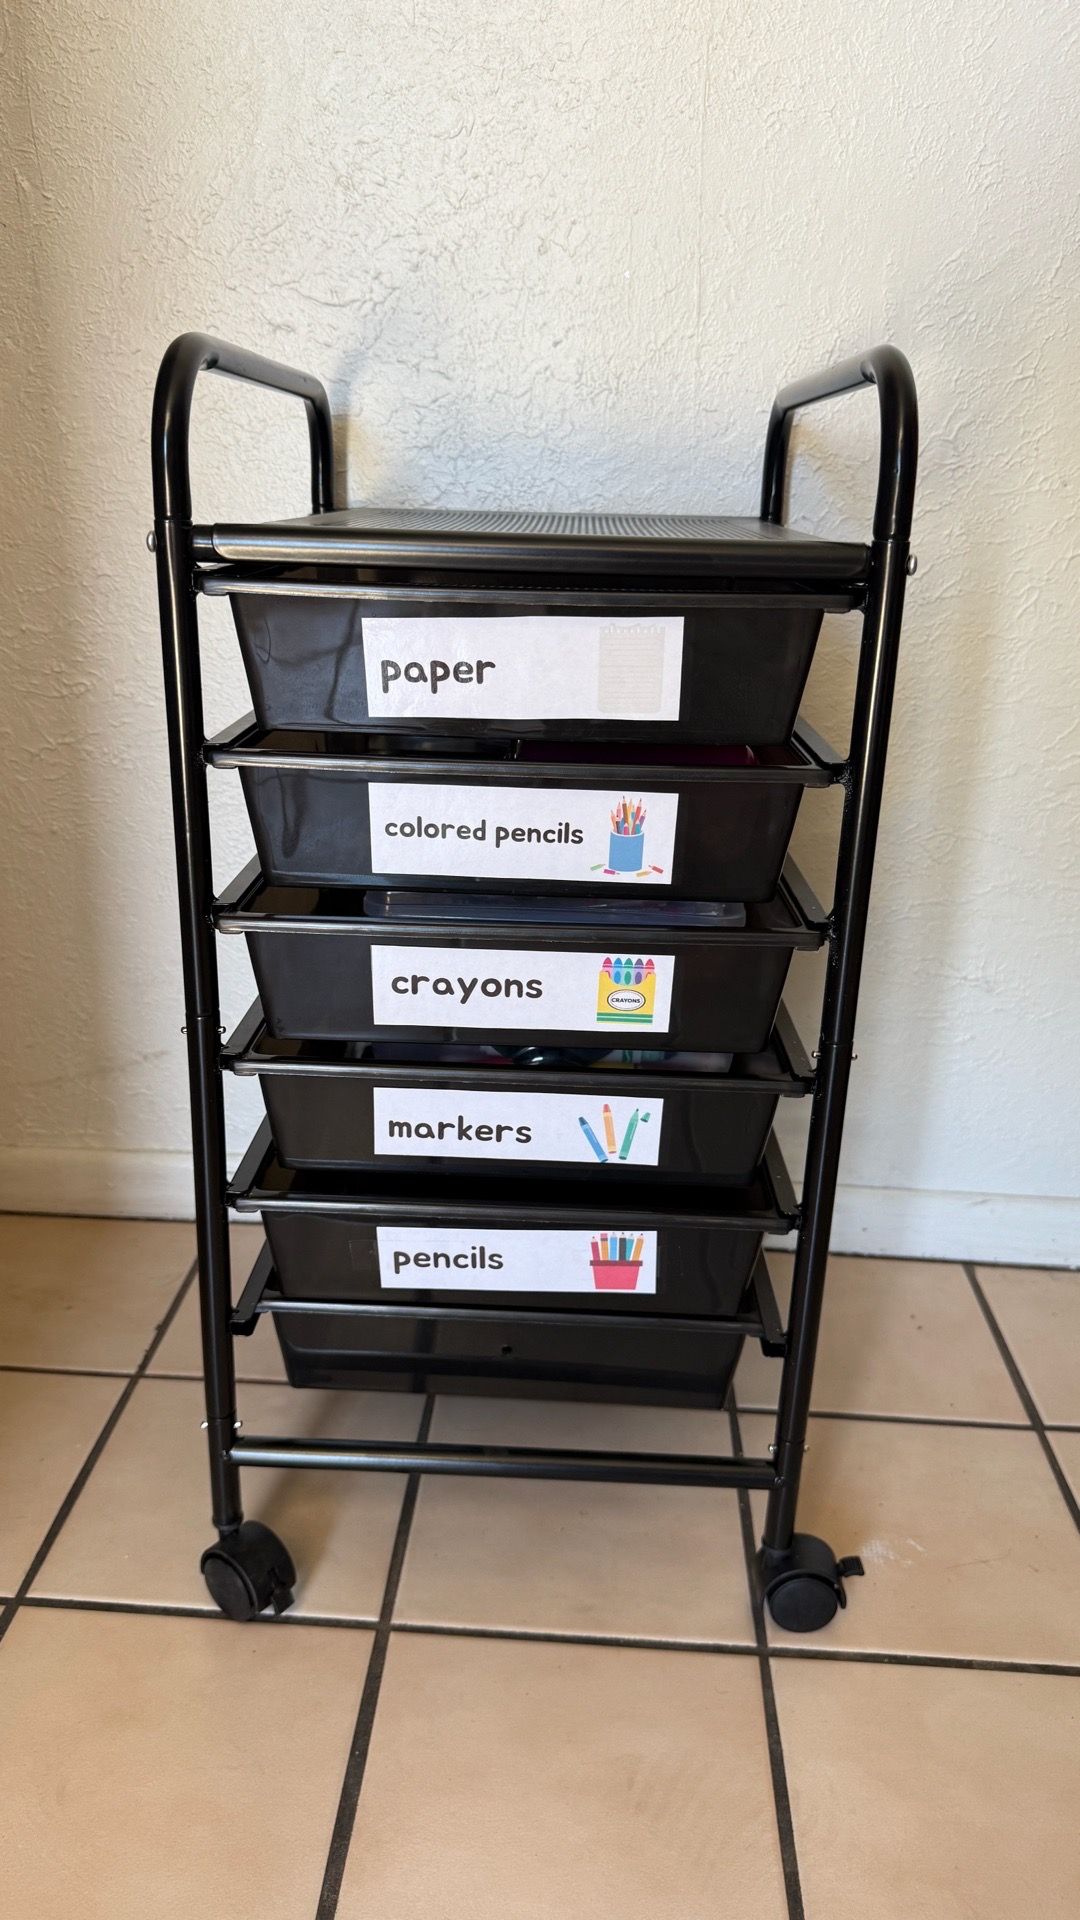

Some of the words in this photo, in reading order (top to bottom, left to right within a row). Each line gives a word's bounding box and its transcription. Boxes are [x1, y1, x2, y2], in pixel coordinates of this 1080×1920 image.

[381, 659, 496, 694] paper
[384, 815, 486, 841] colored
[495, 822, 584, 849] pencils
[391, 974, 543, 1005] crayons
[388, 1115, 532, 1144] markers
[393, 1245, 504, 1275] pencils
